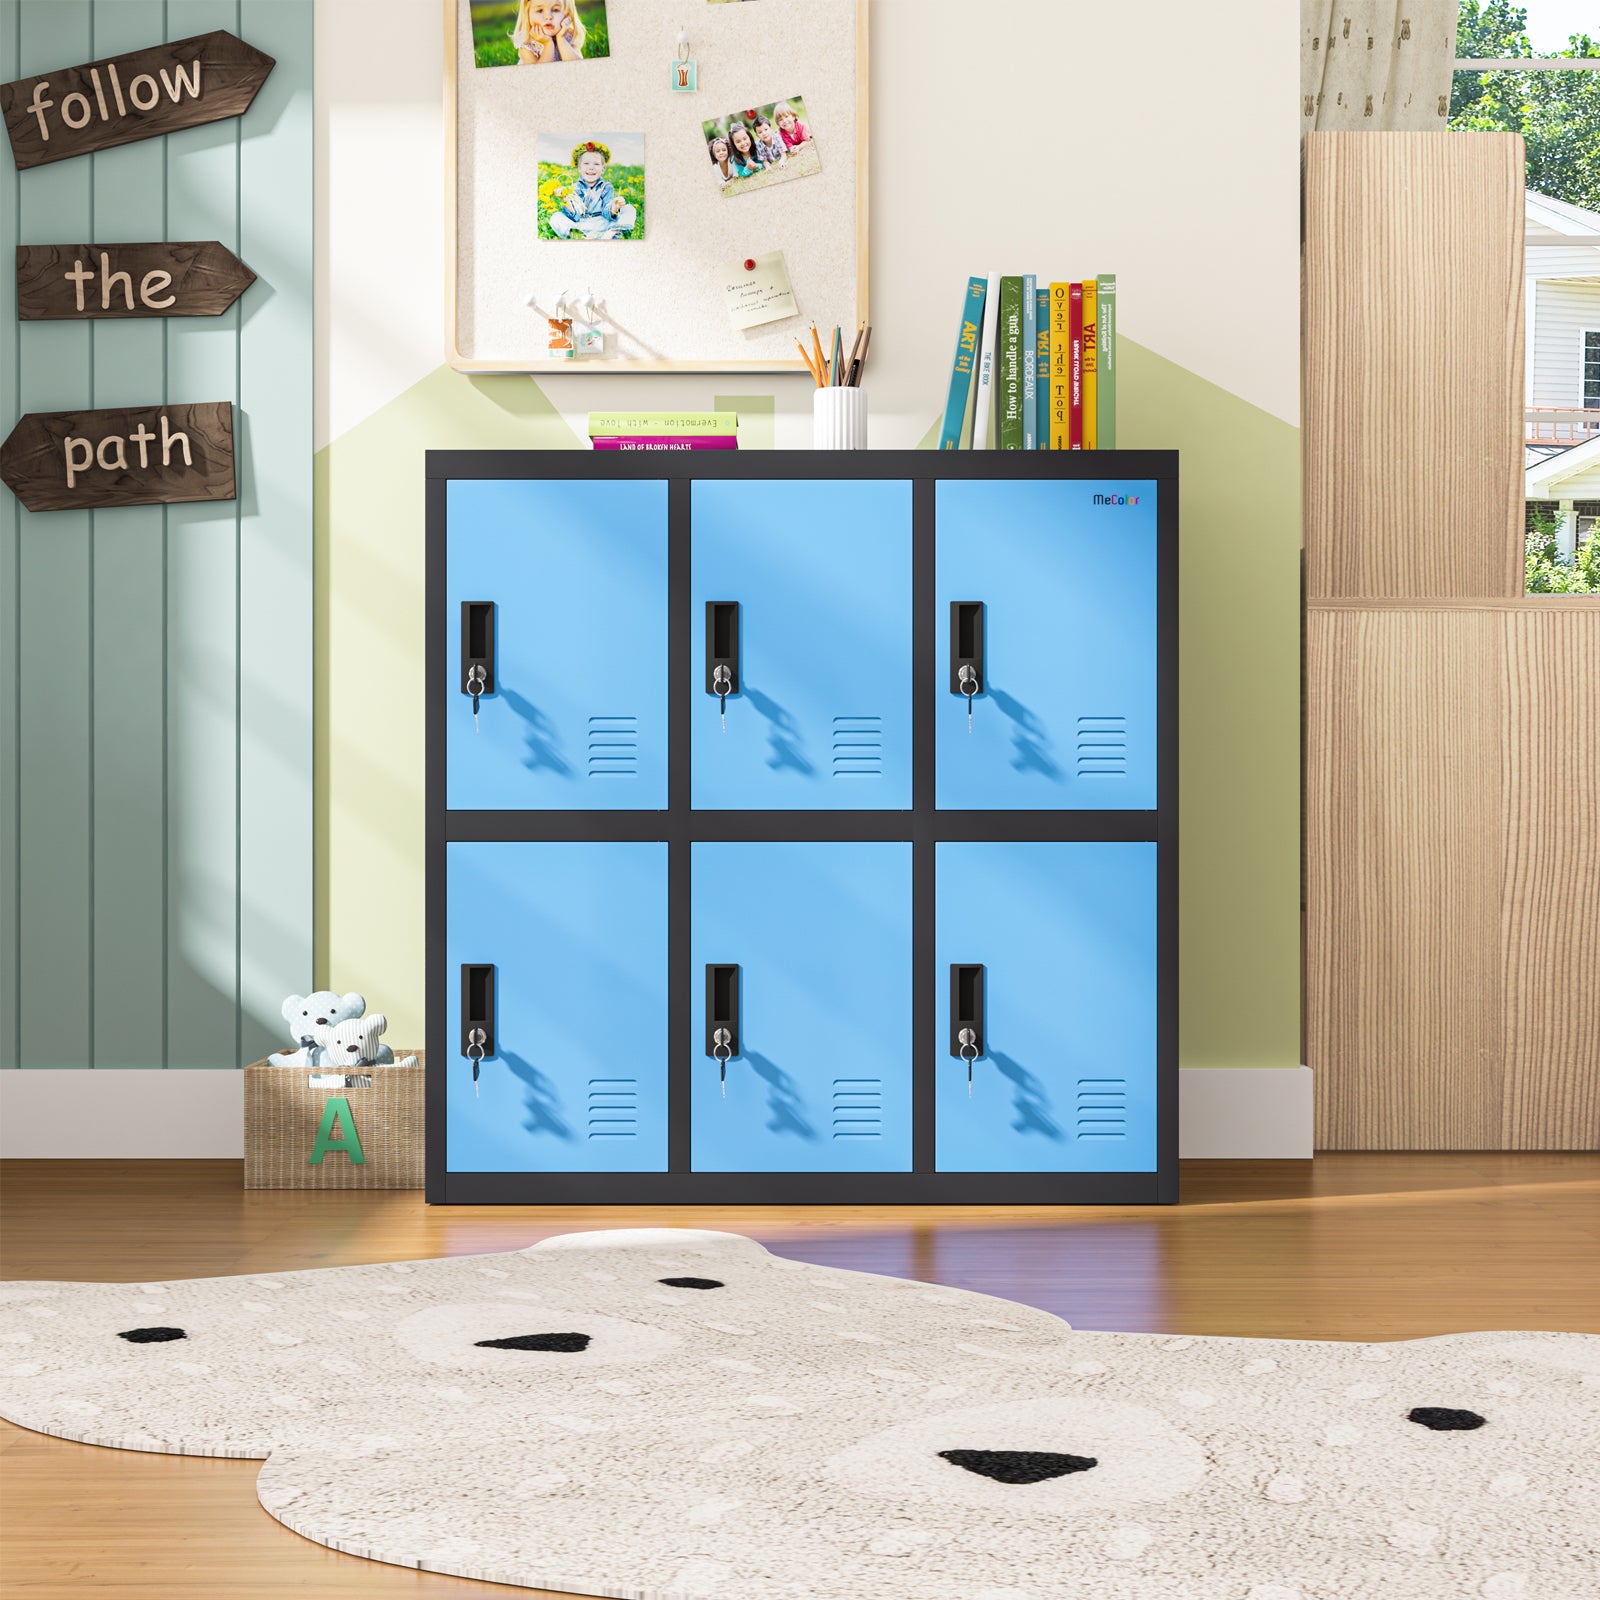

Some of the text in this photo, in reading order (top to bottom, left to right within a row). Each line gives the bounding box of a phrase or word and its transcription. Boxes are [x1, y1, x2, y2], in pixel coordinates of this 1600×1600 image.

[27, 60, 201, 141] follow
[64, 252, 176, 311] the
[960, 320, 977, 353] ART
[1008, 315, 1019, 335] gun
[1006, 344, 1017, 380] handle
[1024, 350, 1034, 400] BORDEAUX
[1007, 382, 1017, 392] to
[1006, 395, 1017, 419] How
[600, 419, 620, 427] love
[627, 419, 649, 427] with
[664, 419, 717, 428] Evermotion
[64, 415, 193, 489] path
[1093, 494, 1140, 505] MeColor
[308, 1097, 366, 1164] A
